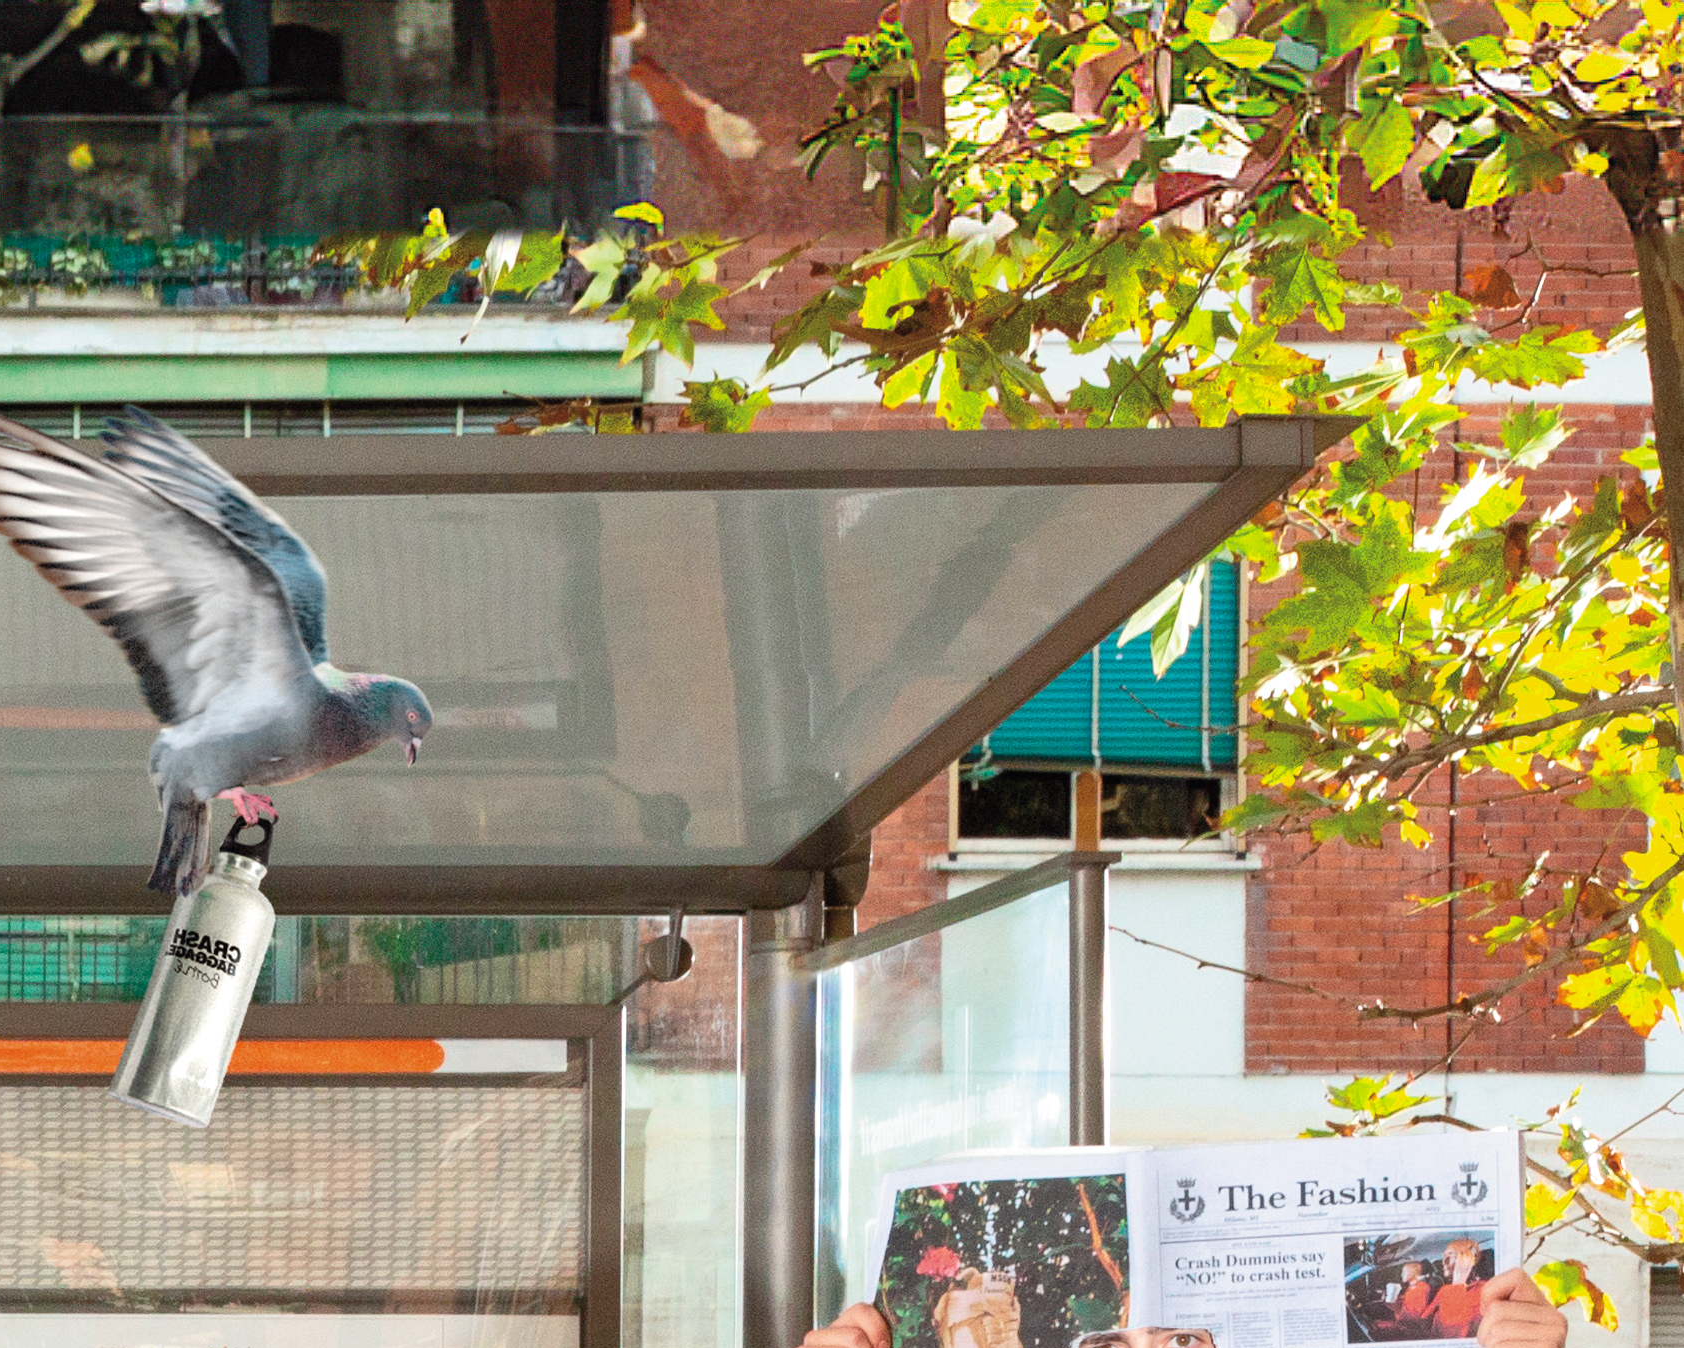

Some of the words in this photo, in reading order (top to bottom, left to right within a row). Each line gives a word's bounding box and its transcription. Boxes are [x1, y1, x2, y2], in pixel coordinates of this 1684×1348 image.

[1218, 1185, 1286, 1212] The
[1296, 1176, 1437, 1208] Fashion
[1175, 1254, 1221, 1270] Crash
[1226, 1250, 1297, 1267] Dummies
[1301, 1251, 1326, 1265] say
[1231, 1271, 1245, 1283] to
[1249, 1268, 1290, 1282] crash
[1296, 1266, 1326, 1280] test.
